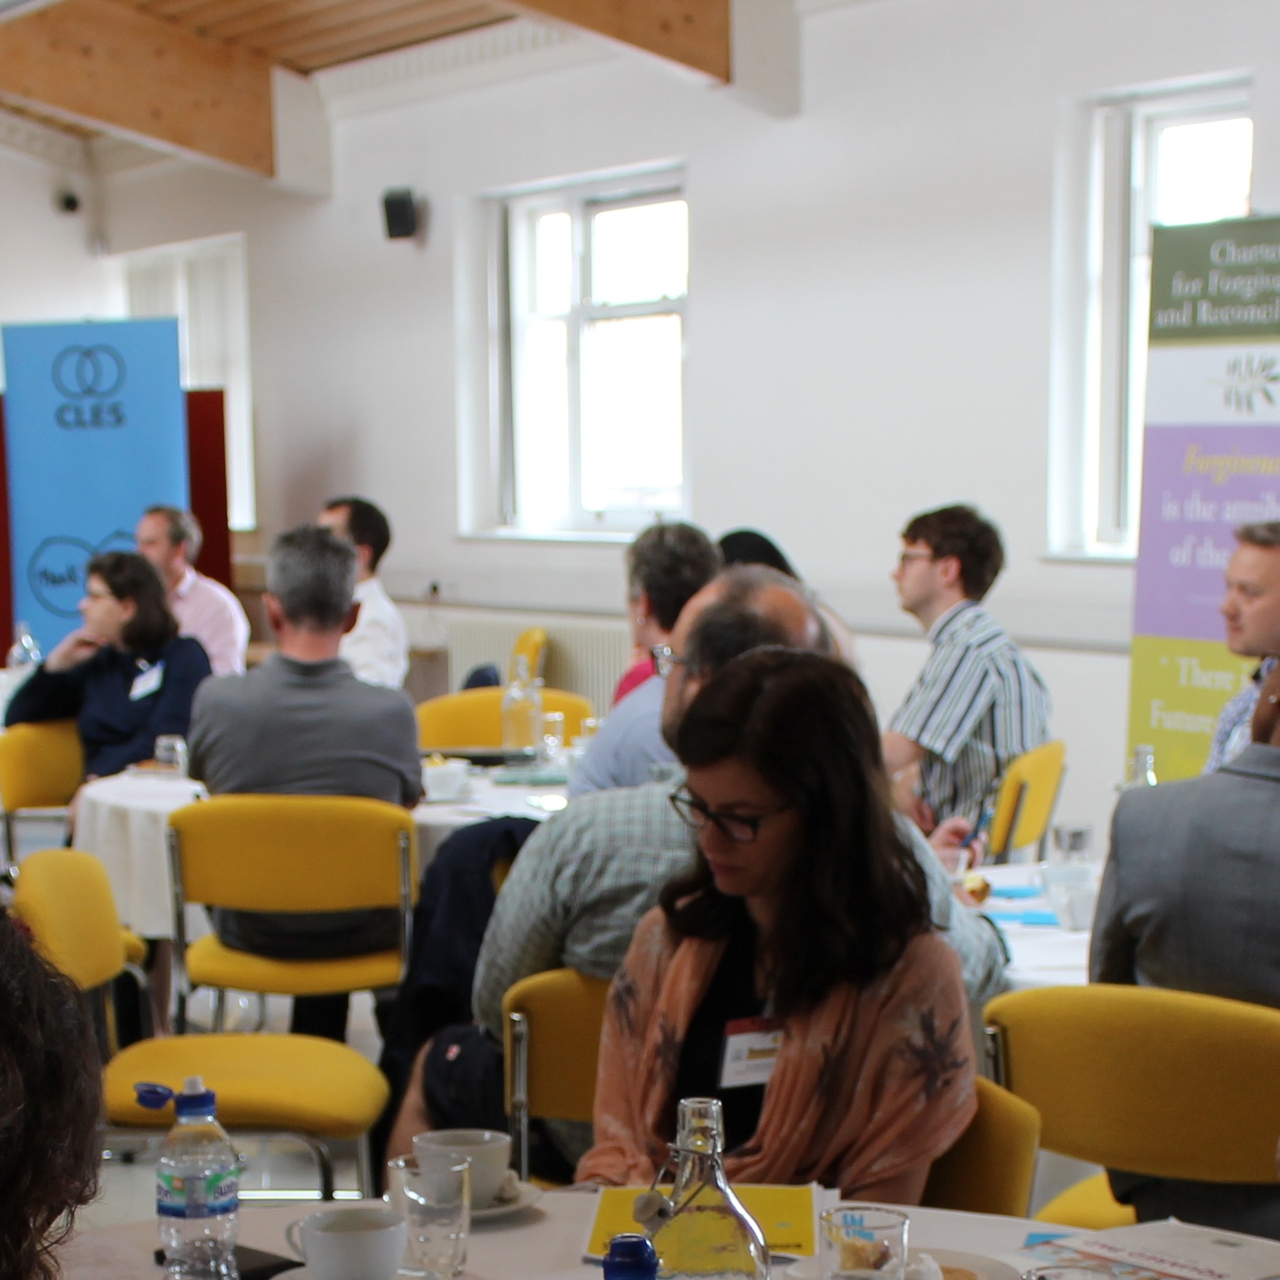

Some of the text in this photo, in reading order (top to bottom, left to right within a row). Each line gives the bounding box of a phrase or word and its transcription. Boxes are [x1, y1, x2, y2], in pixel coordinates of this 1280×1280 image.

[1172, 271, 1203, 297] for
[1154, 302, 1192, 328] and
[55, 403, 124, 429] CLES
